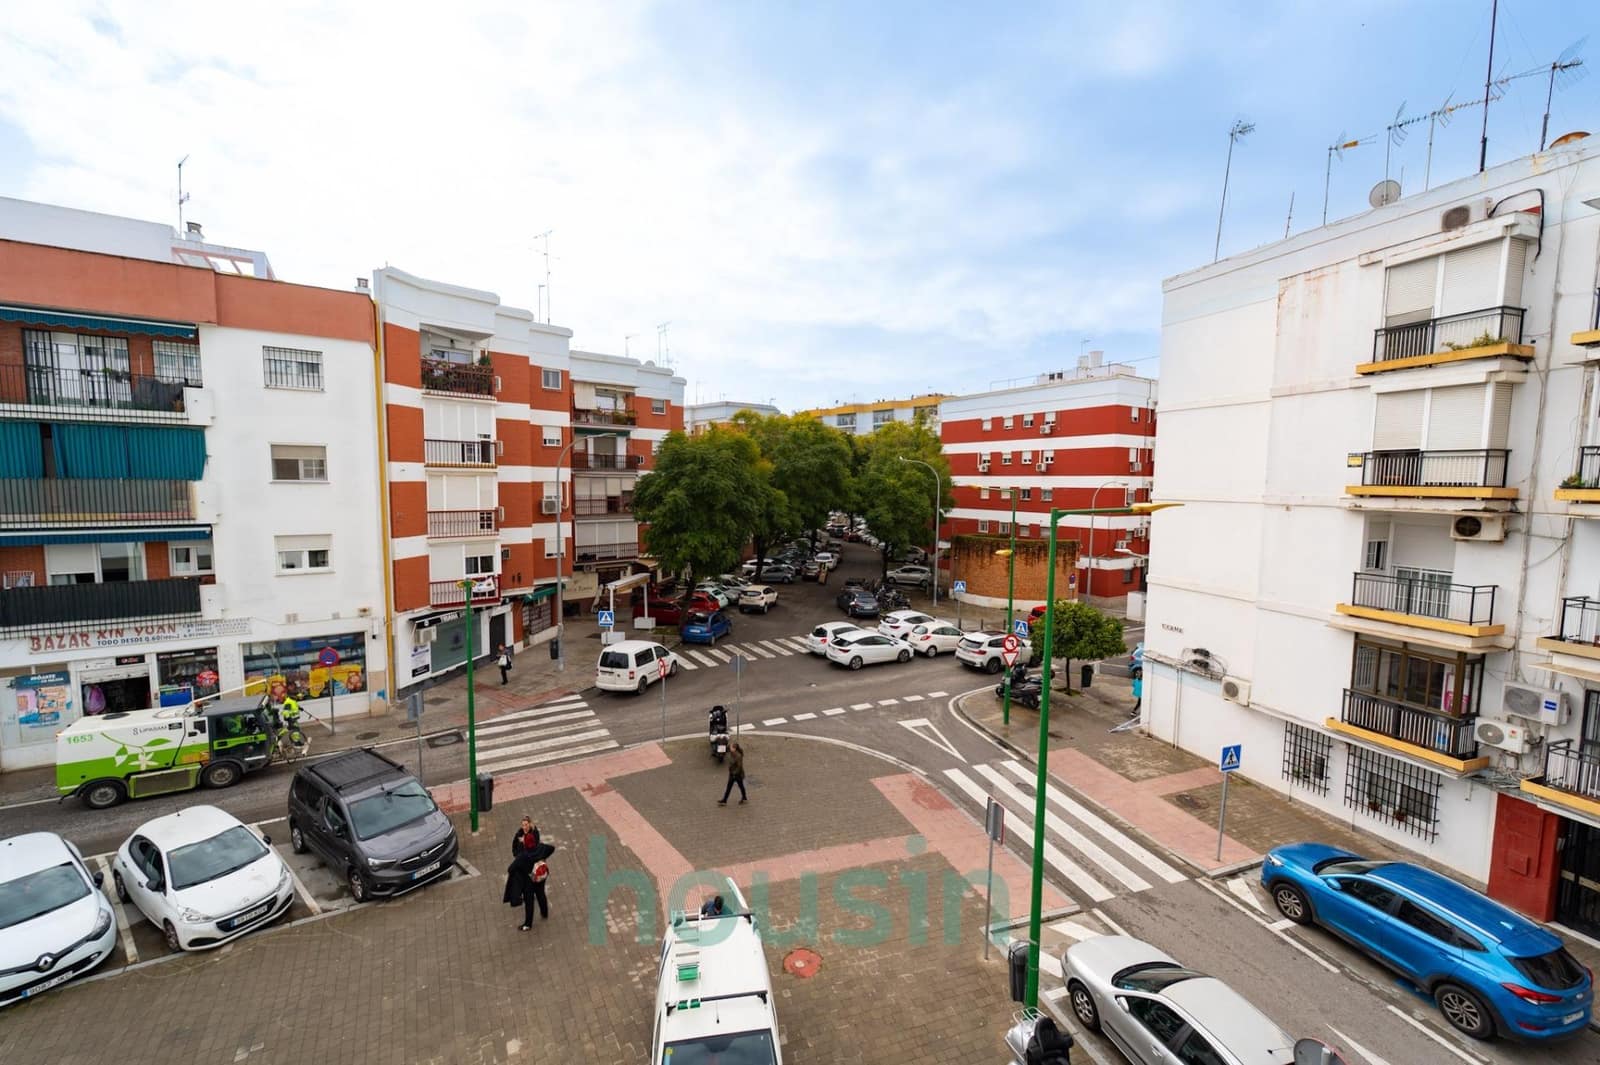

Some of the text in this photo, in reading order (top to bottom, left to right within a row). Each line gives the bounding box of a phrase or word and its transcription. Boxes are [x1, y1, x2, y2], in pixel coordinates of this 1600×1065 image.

[30, 632, 91, 651] BAZAR
[96, 627, 124, 639] XIN
[134, 622, 176, 636] YUAN
[66, 734, 94, 744] 1653
